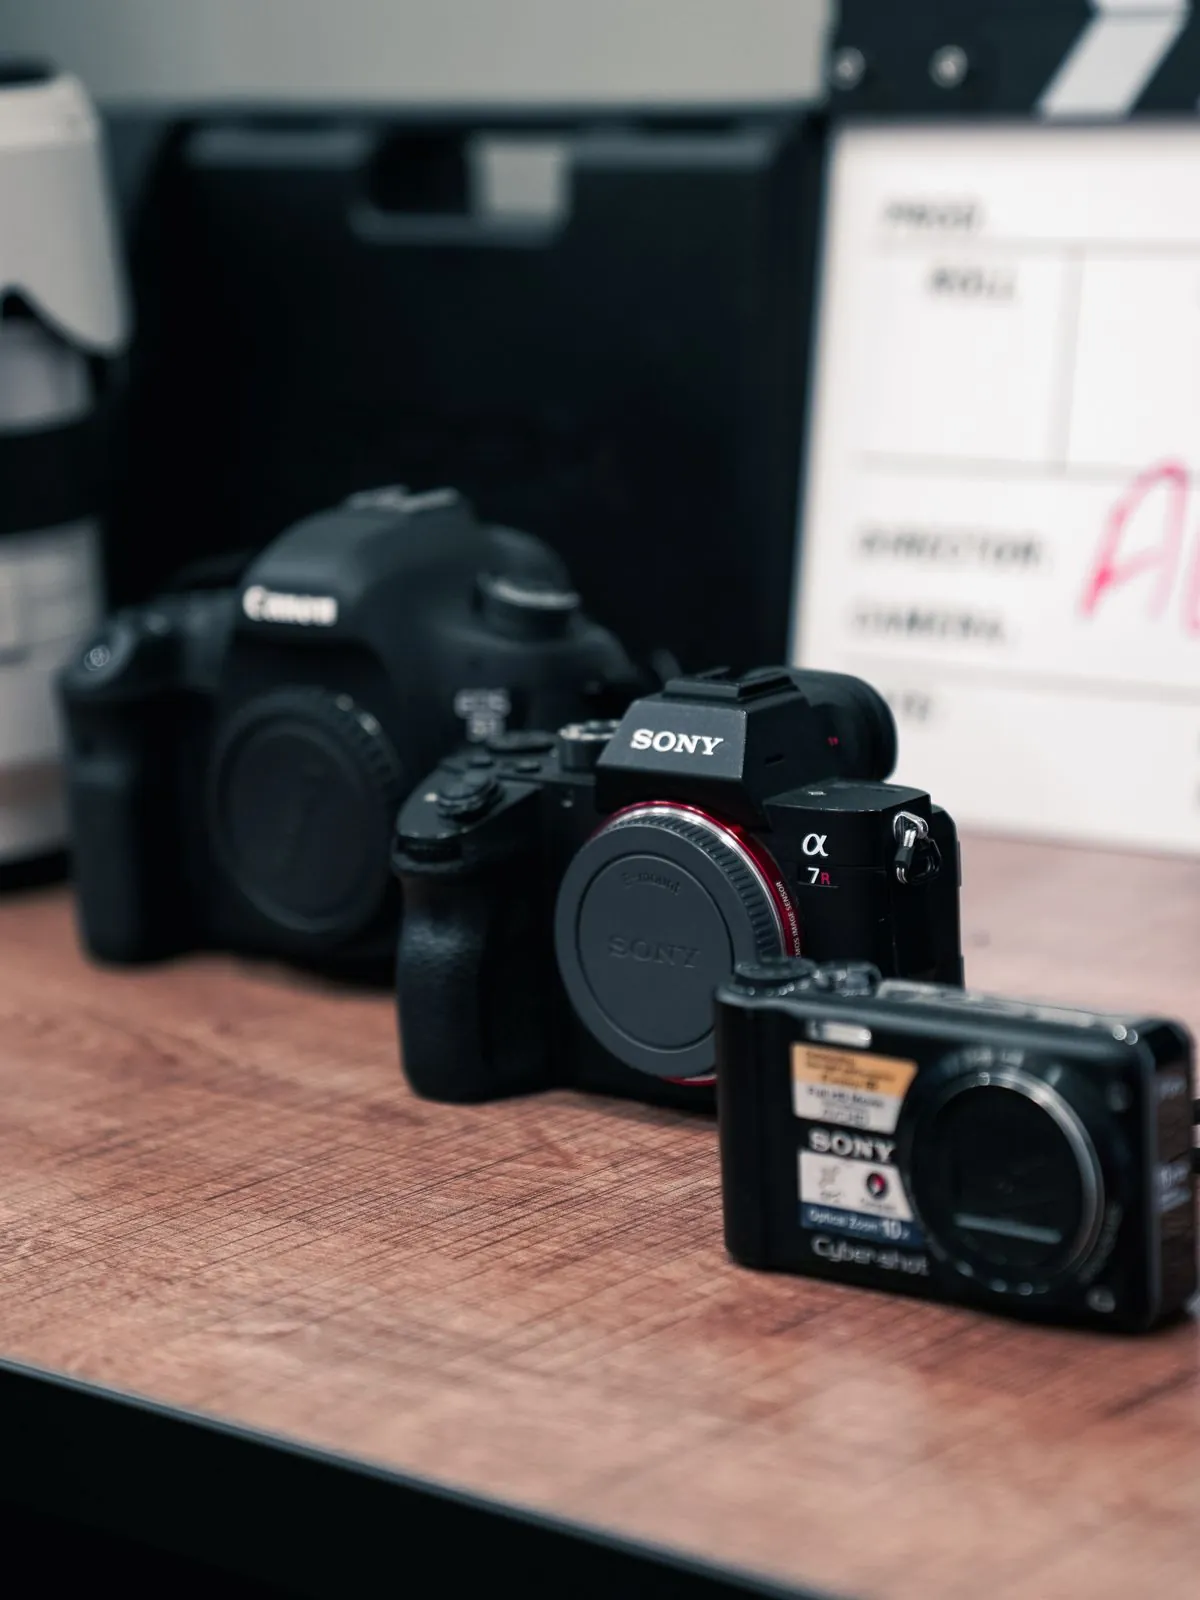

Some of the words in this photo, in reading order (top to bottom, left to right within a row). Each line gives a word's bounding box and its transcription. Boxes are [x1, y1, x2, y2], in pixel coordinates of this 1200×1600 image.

[630, 728, 723, 756] SONY
[807, 867, 831, 885] 7R
[775, 880, 793, 911] SENSOR
[787, 911, 799, 937] IMAGE
[607, 933, 701, 968] SONY
[808, 1128, 896, 1162] SONY
